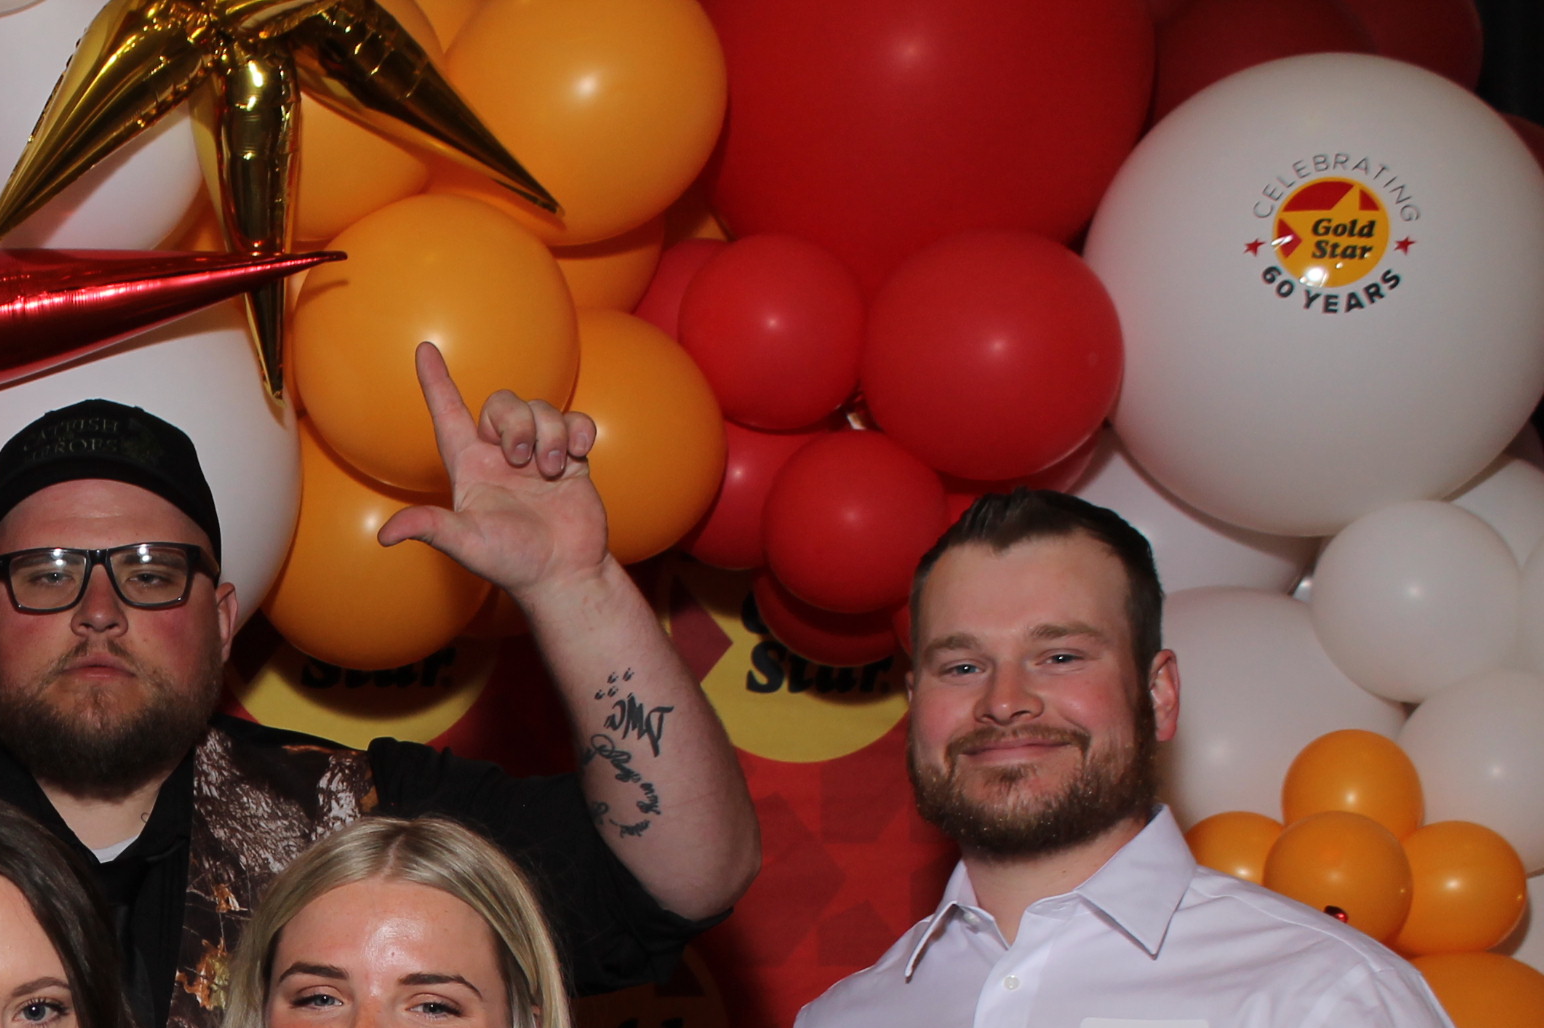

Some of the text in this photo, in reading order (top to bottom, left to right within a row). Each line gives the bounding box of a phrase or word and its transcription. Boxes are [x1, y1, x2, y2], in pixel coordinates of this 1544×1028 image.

[1253, 153, 1420, 222] CELEBRATING
[1312, 218, 1376, 238] Gold
[1312, 240, 1373, 259] Star
[1262, 266, 1402, 314] 60 YEARS
